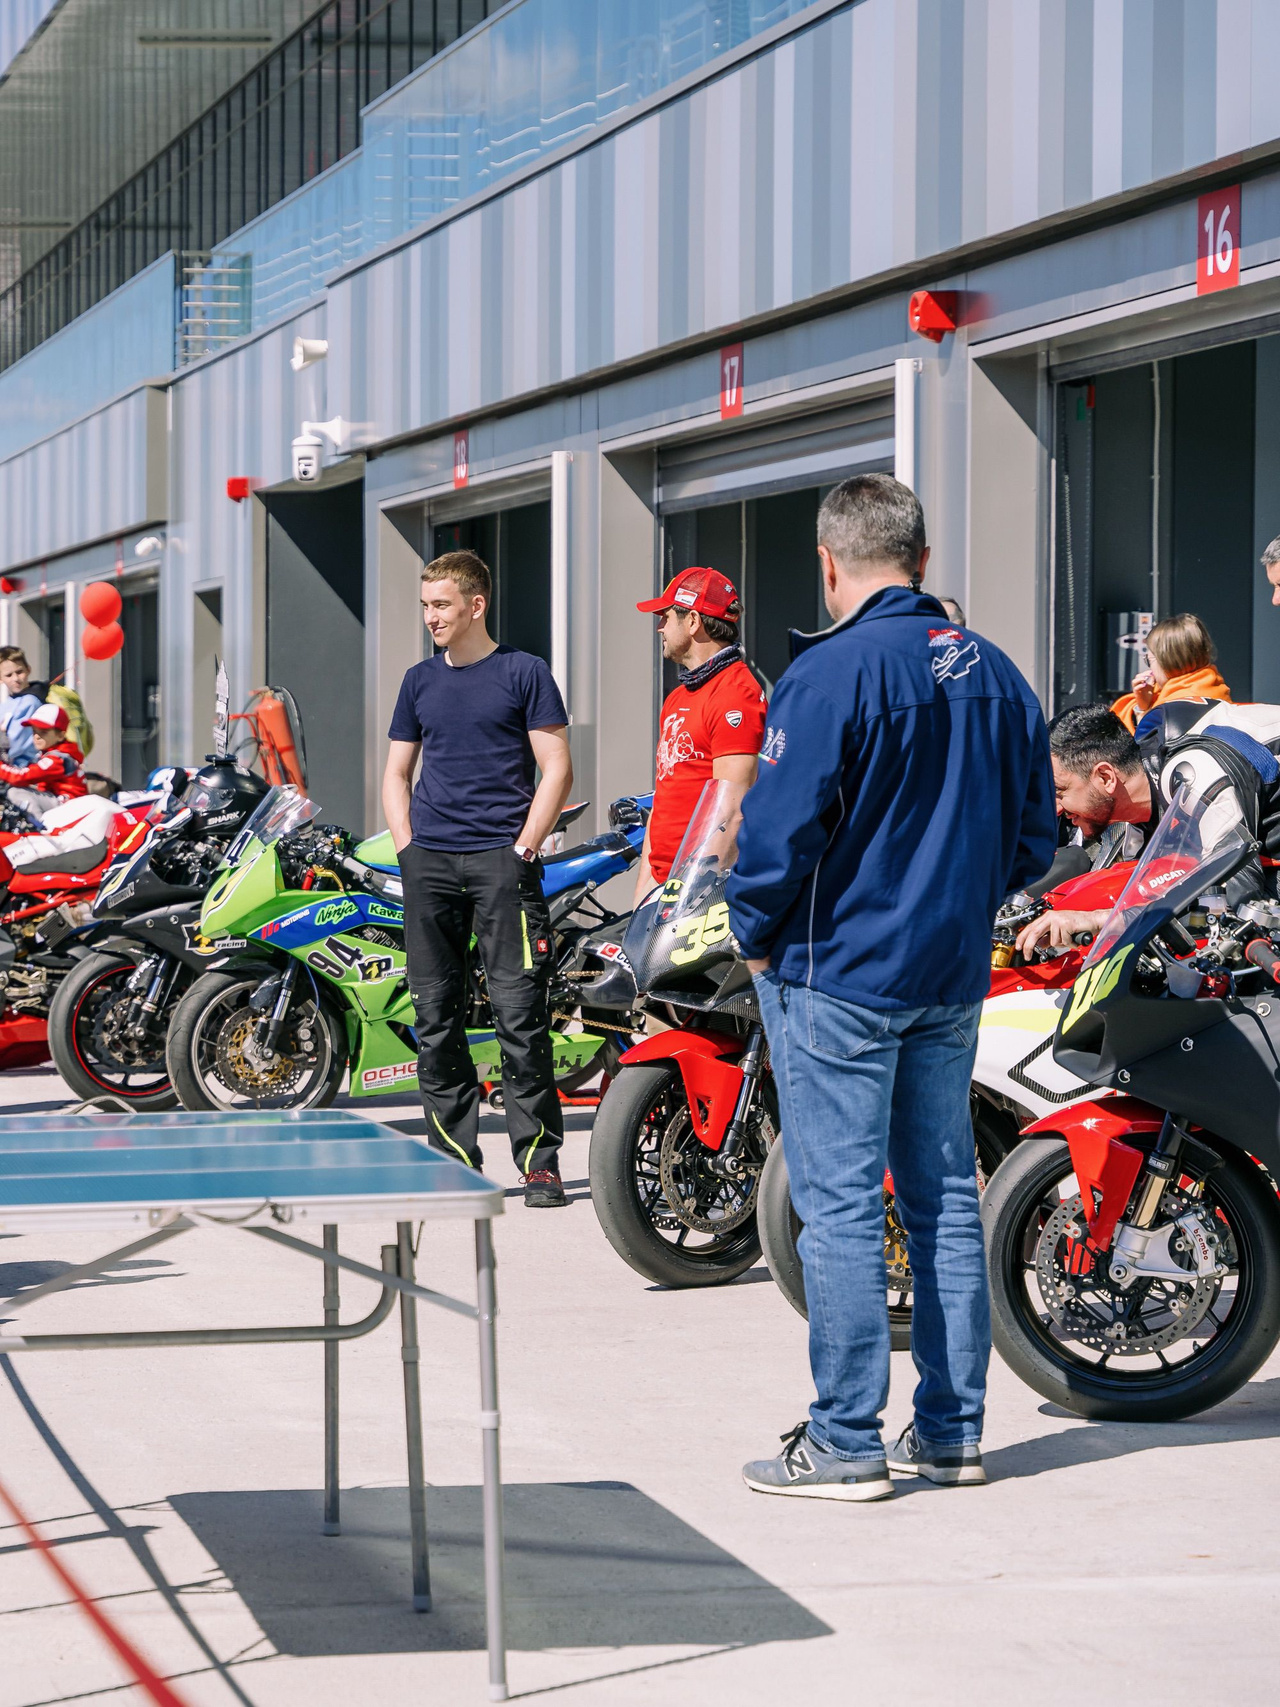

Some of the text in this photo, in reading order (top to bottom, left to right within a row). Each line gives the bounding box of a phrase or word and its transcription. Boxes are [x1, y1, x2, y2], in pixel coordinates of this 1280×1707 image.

[1204, 204, 1233, 276] 16
[724, 356, 739, 408] 17
[456, 440, 466, 479] 18
[207, 811, 239, 826] SHARK
[226, 830, 255, 868] 4
[315, 901, 359, 925] Ninja
[370, 904, 404, 920] Kawa
[216, 940, 246, 949] racing
[671, 901, 731, 966] 35
[307, 936, 365, 979] 94
[1193, 1228, 1210, 1261] brembo
